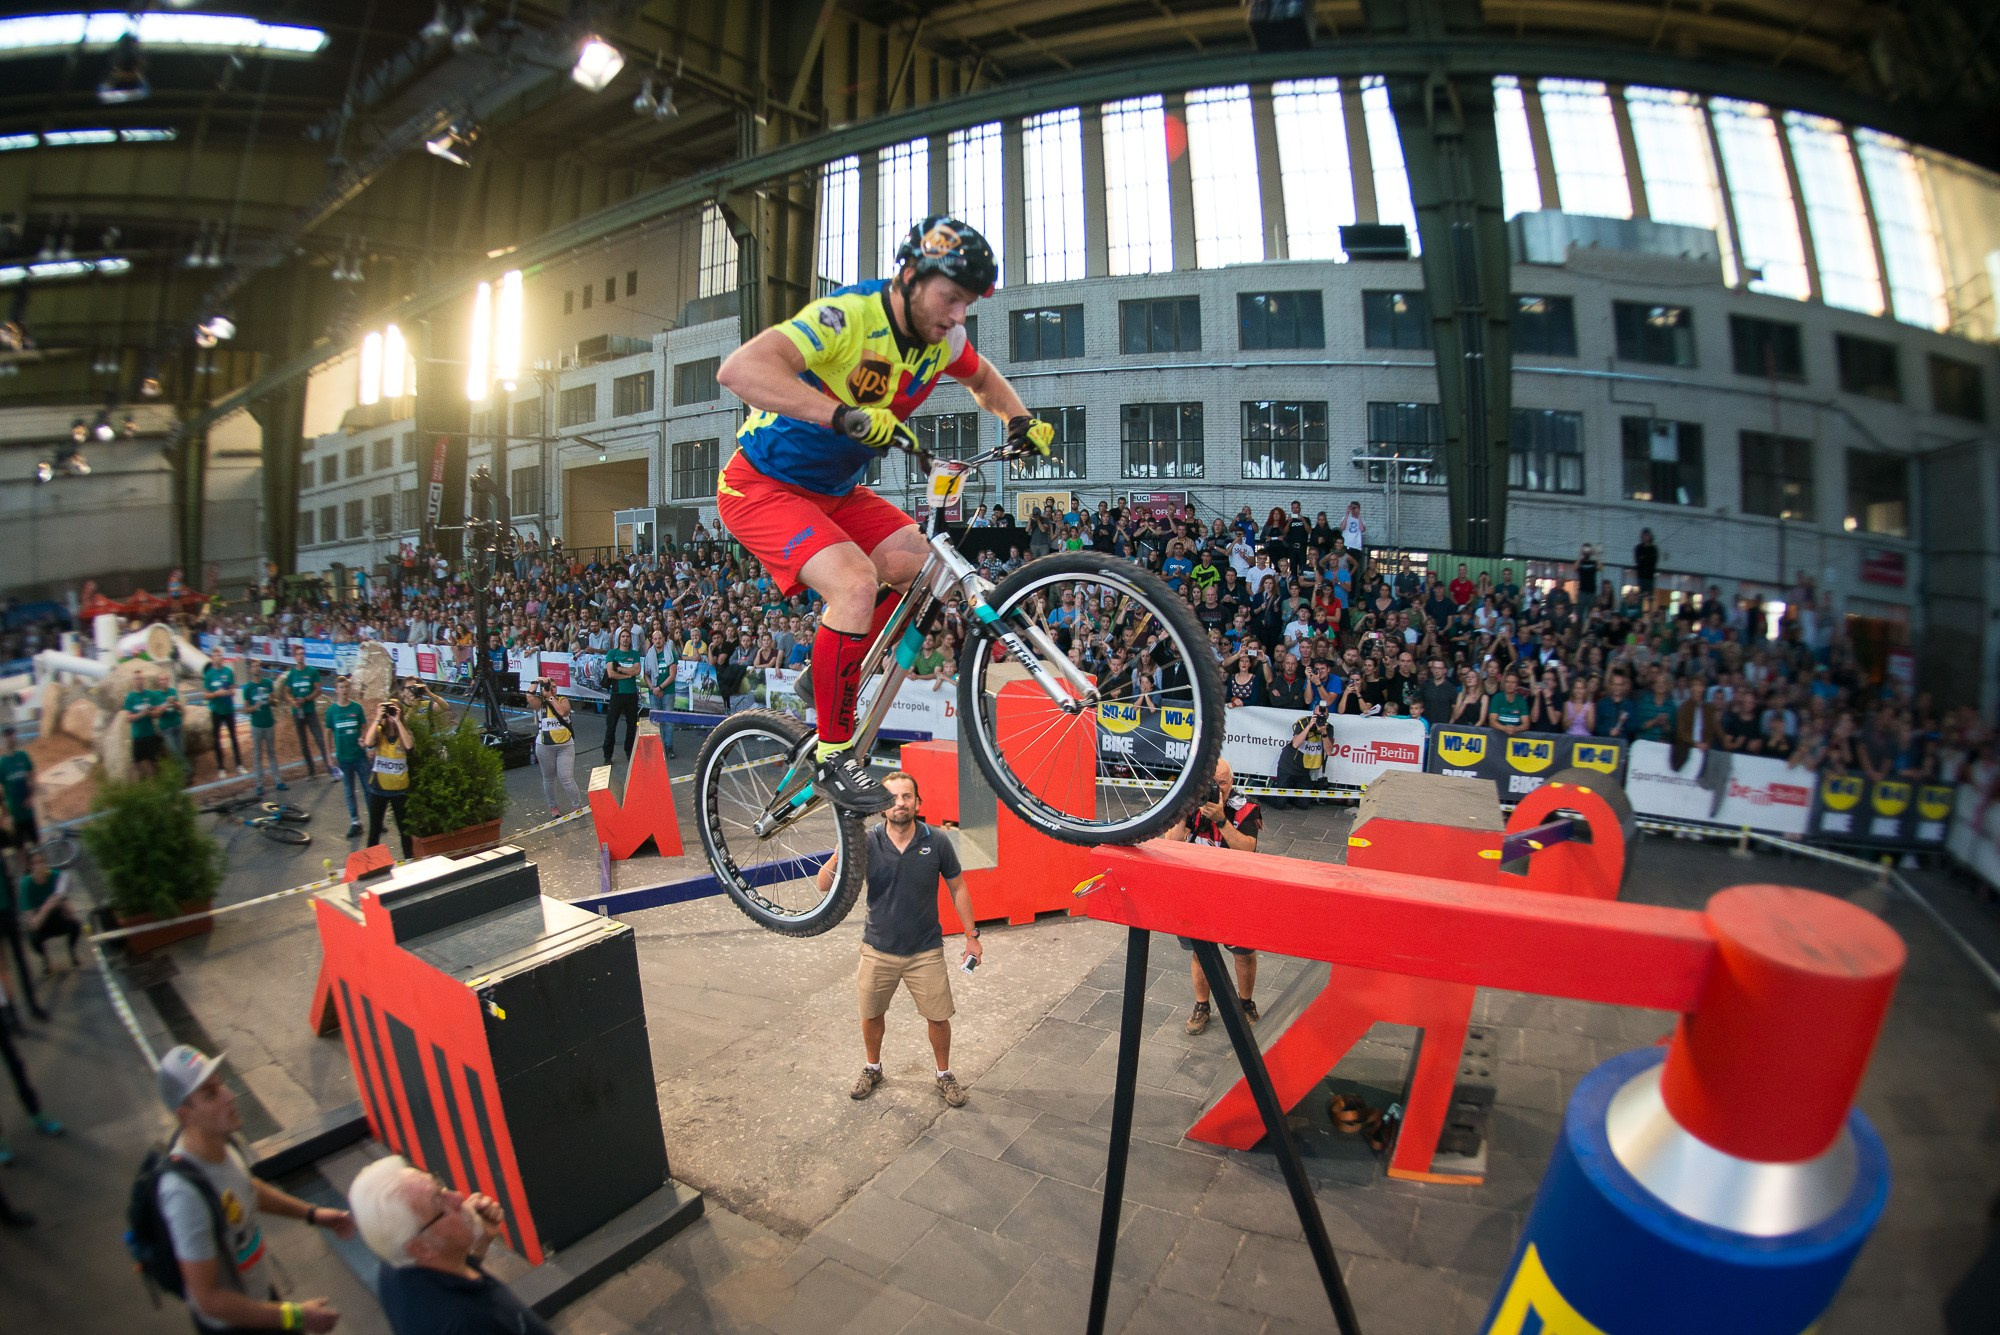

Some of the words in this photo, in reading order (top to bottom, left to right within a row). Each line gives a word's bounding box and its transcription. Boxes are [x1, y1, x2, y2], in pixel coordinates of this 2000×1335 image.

[852, 366, 888, 398] ups
[429, 485, 440, 516] UCI
[838, 681, 858, 733] JITSIE
[860, 697, 930, 712] Spetropole
[945, 701, 958, 718] b
[1165, 710, 1195, 727] WD-4
[1102, 734, 1136, 754] BIKE
[1165, 741, 1190, 760] BIK
[1379, 746, 1415, 760] Berlin
[1443, 735, 1482, 754] WD-40
[1511, 741, 1549, 759] WD-40
[377, 760, 405, 771] PHOTO
